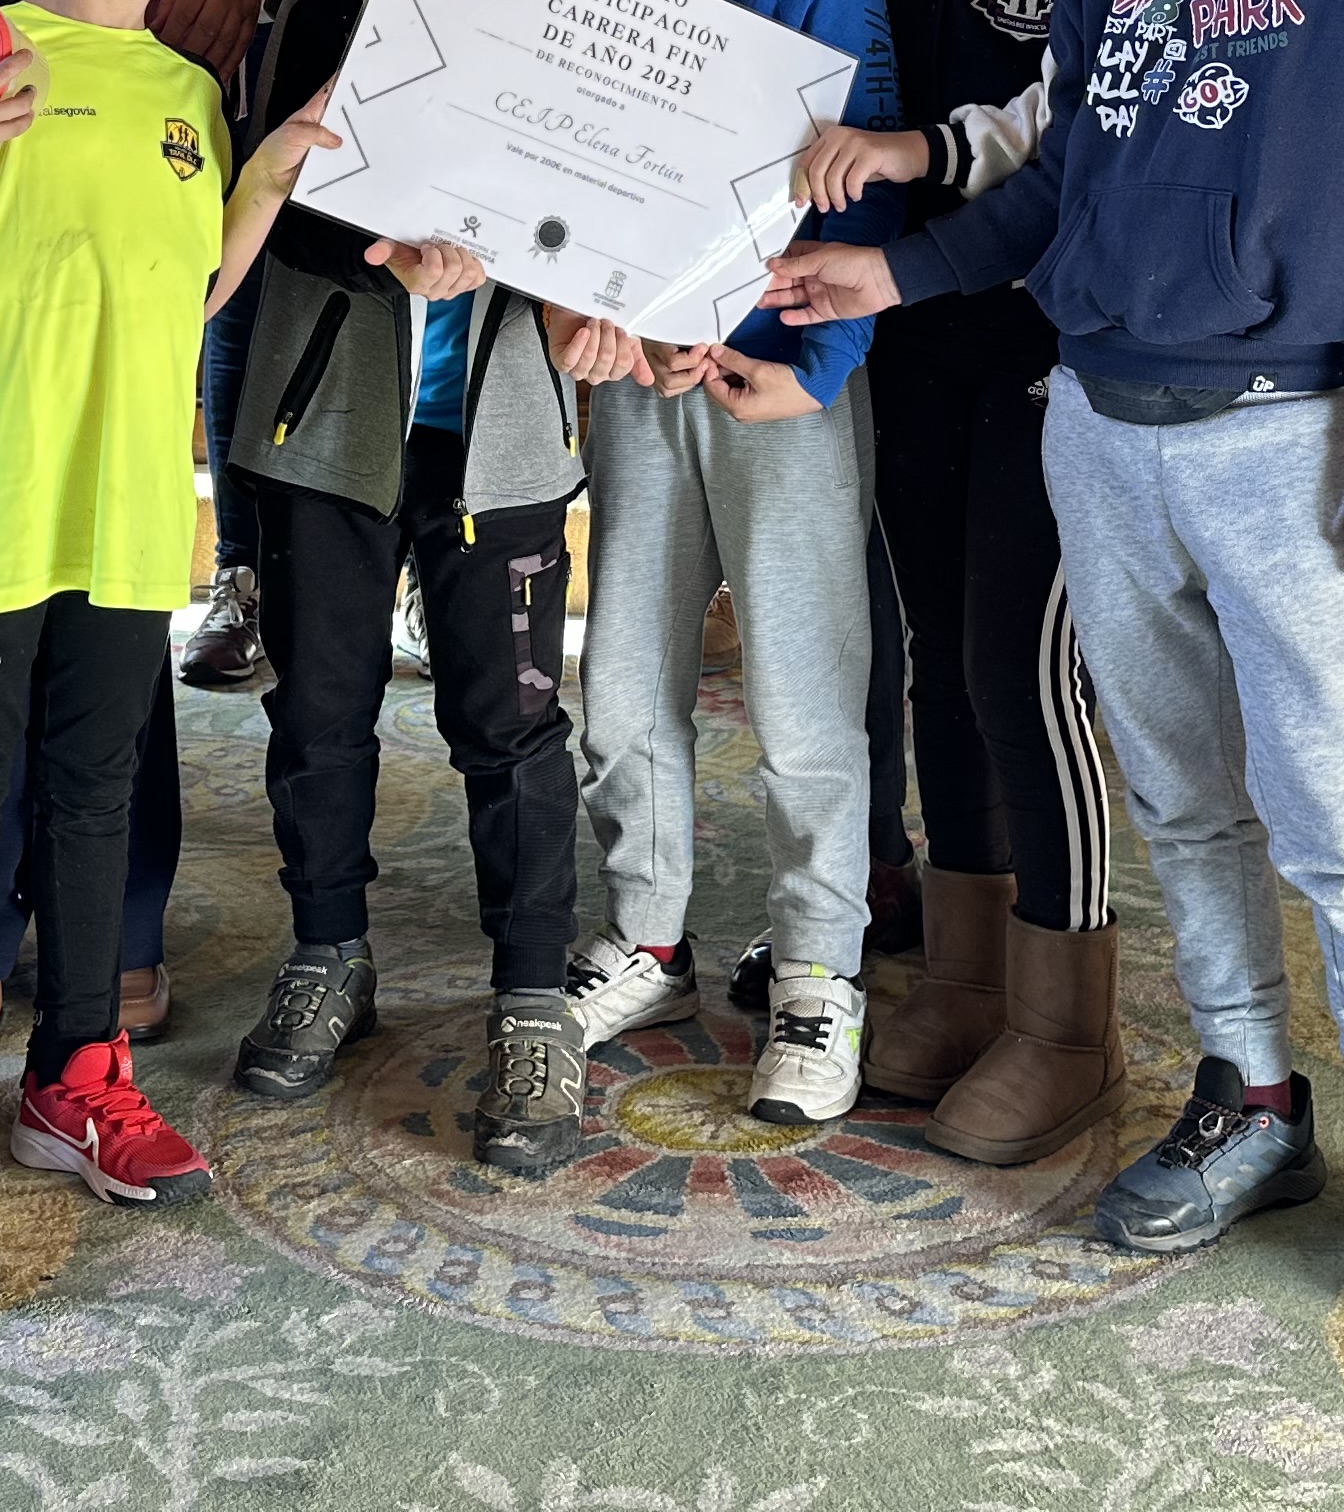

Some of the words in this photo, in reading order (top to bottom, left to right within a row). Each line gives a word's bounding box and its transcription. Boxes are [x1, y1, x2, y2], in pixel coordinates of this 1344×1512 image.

[542, 23, 575, 48] DE
[582, 42, 632, 71] AÑO
[640, 64, 692, 96] 2023
[665, 44, 707, 72] FIN
[1097, 38, 1149, 74] LAY
[1227, 31, 1289, 58] FRIENDS
[536, 49, 554, 64] DE
[557, 57, 677, 113] RECONOCIMIENTO
[1086, 71, 1140, 105] ALL
[1181, 77, 1234, 111] GO!
[576, 87, 617, 108] otorgado
[619, 103, 626, 111] a
[495, 91, 574, 131] CEIP
[574, 124, 621, 158] Elena
[625, 145, 684, 184] Fortún
[1095, 104, 1139, 138] DAY
[506, 142, 523, 156] Vale
[524, 149, 539, 162] por
[540, 156, 562, 171] 200€
[562, 166, 573, 176] en
[574, 170, 607, 189] material
[607, 182, 645, 204] deportivo
[1252, 375, 1275, 393] UP
